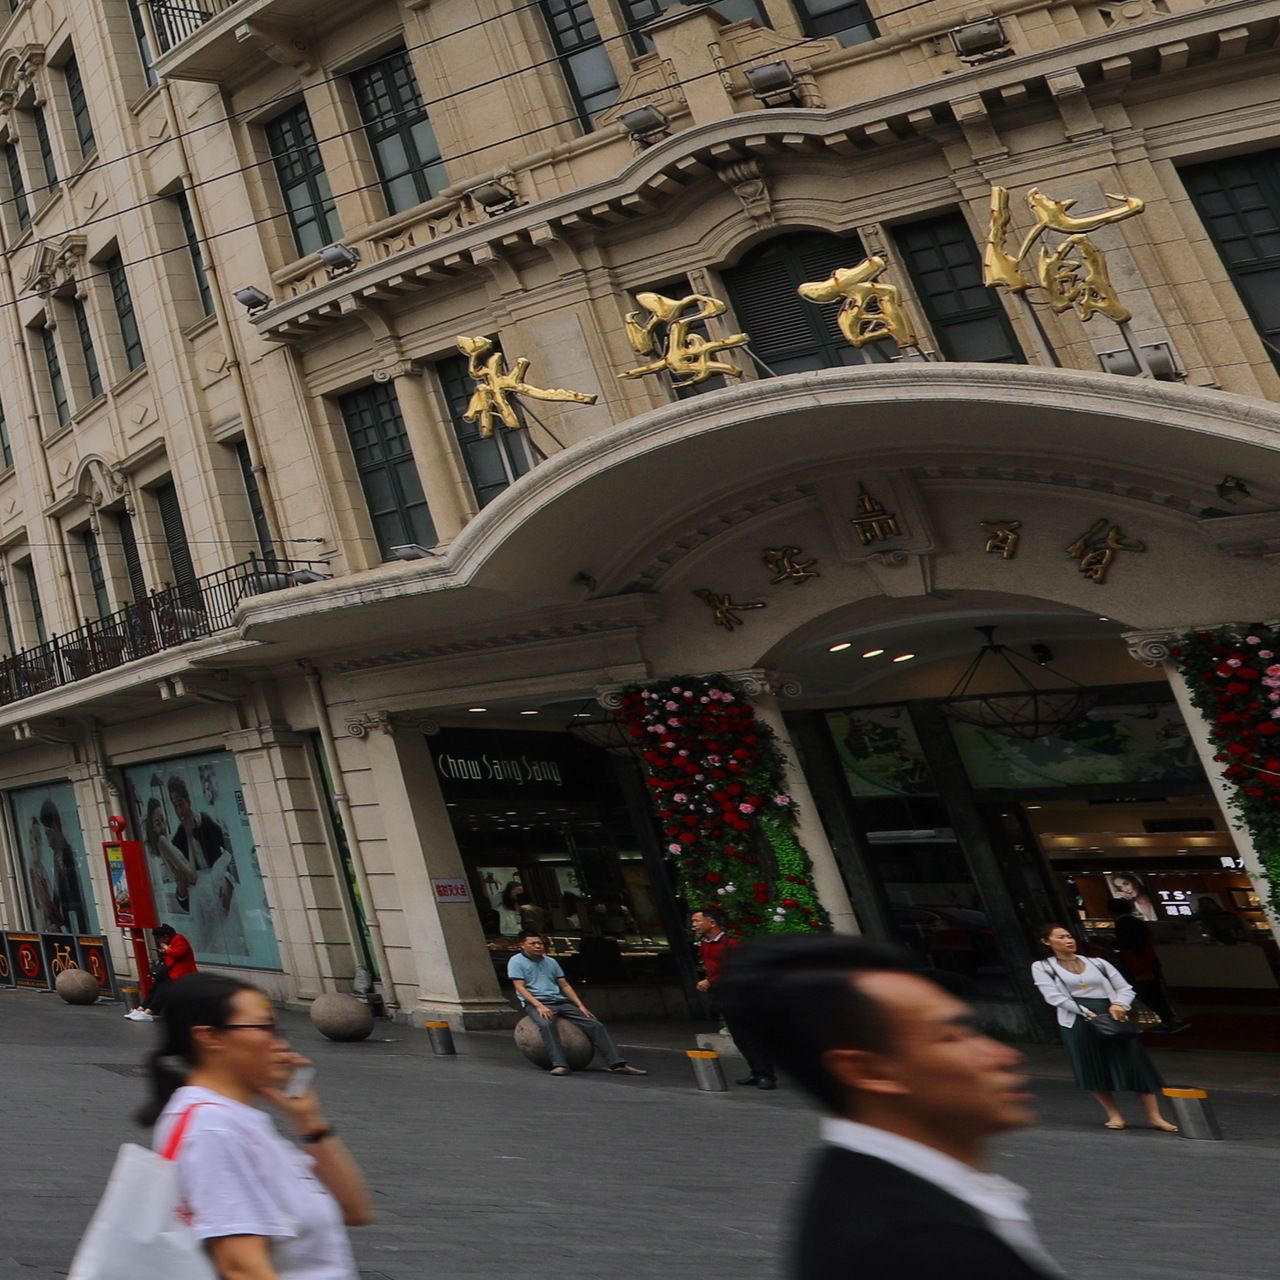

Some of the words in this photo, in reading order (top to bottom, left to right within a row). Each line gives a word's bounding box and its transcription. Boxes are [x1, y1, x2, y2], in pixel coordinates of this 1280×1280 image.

[438, 753, 482, 780] Chow
[482, 754, 524, 786] Sang
[522, 755, 563, 787] Sang
